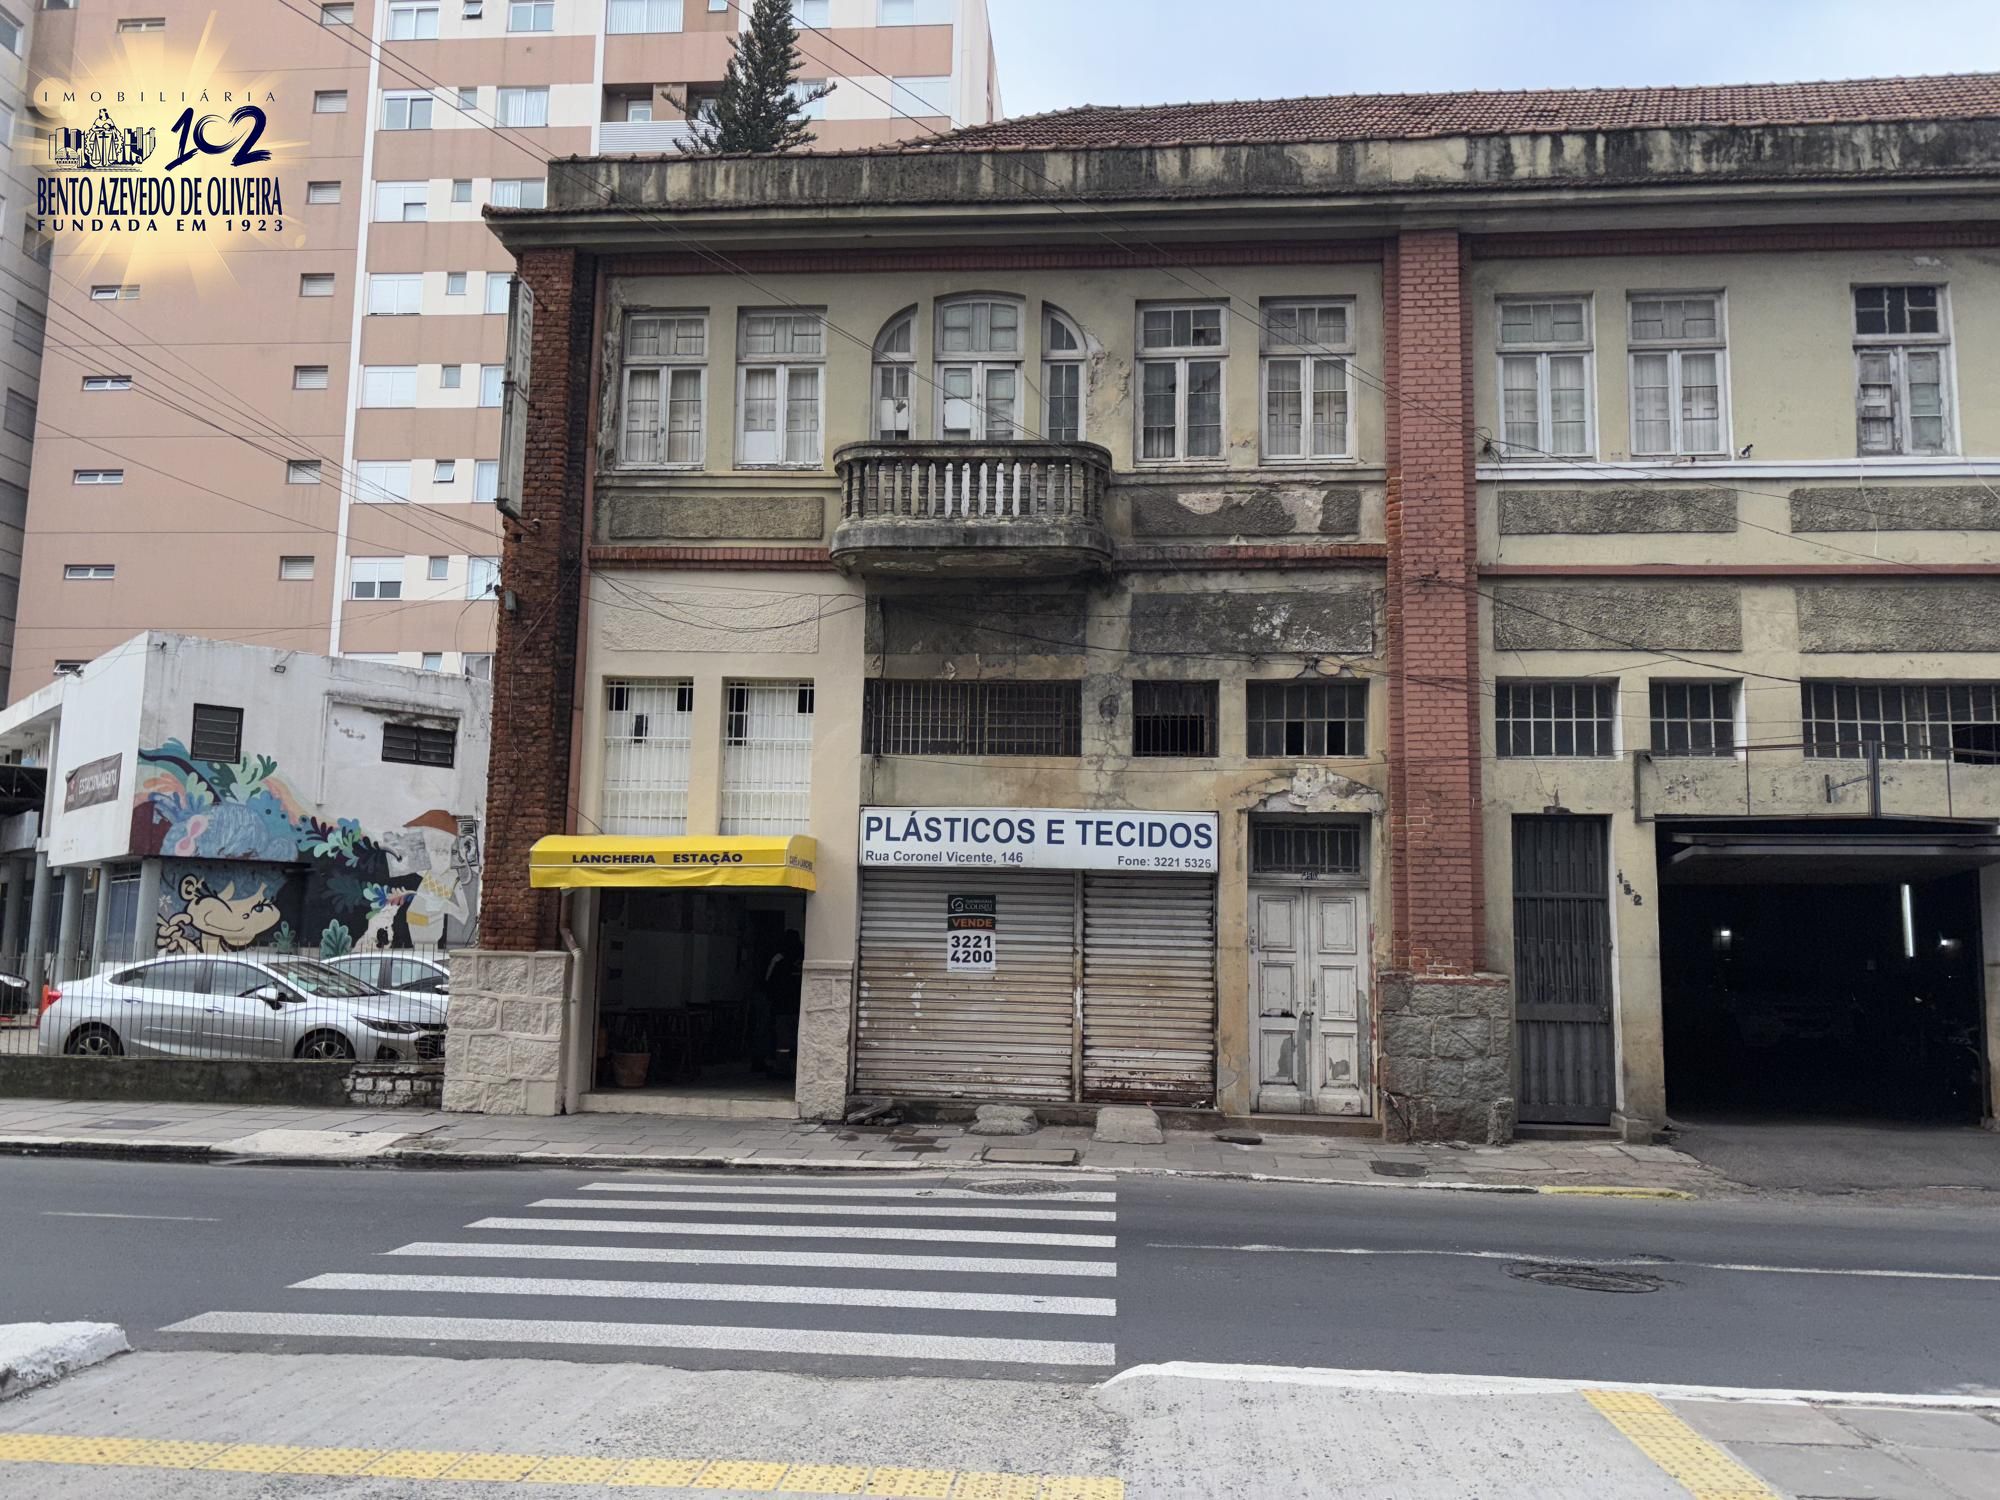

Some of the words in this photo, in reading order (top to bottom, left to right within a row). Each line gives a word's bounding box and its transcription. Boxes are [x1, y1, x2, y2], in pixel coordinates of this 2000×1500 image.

[865, 811, 1036, 844] PLÁSTICOS
[1046, 819, 1065, 845] E
[1075, 820, 1213, 849] TECIDOS
[572, 854, 656, 864] LANCHERIA
[672, 851, 743, 866] ESTAÇÃO
[865, 850, 889, 861] Rua
[893, 851, 942, 862] Coronel
[946, 851, 997, 864] Vicente,
[1001, 852, 1023, 863] 146
[1117, 855, 1150, 867] Fone:
[1154, 857, 1180, 868] 3221
[951, 918, 993, 928] VENDE
[951, 935, 991, 949] 3221
[950, 950, 993, 964] 4200
